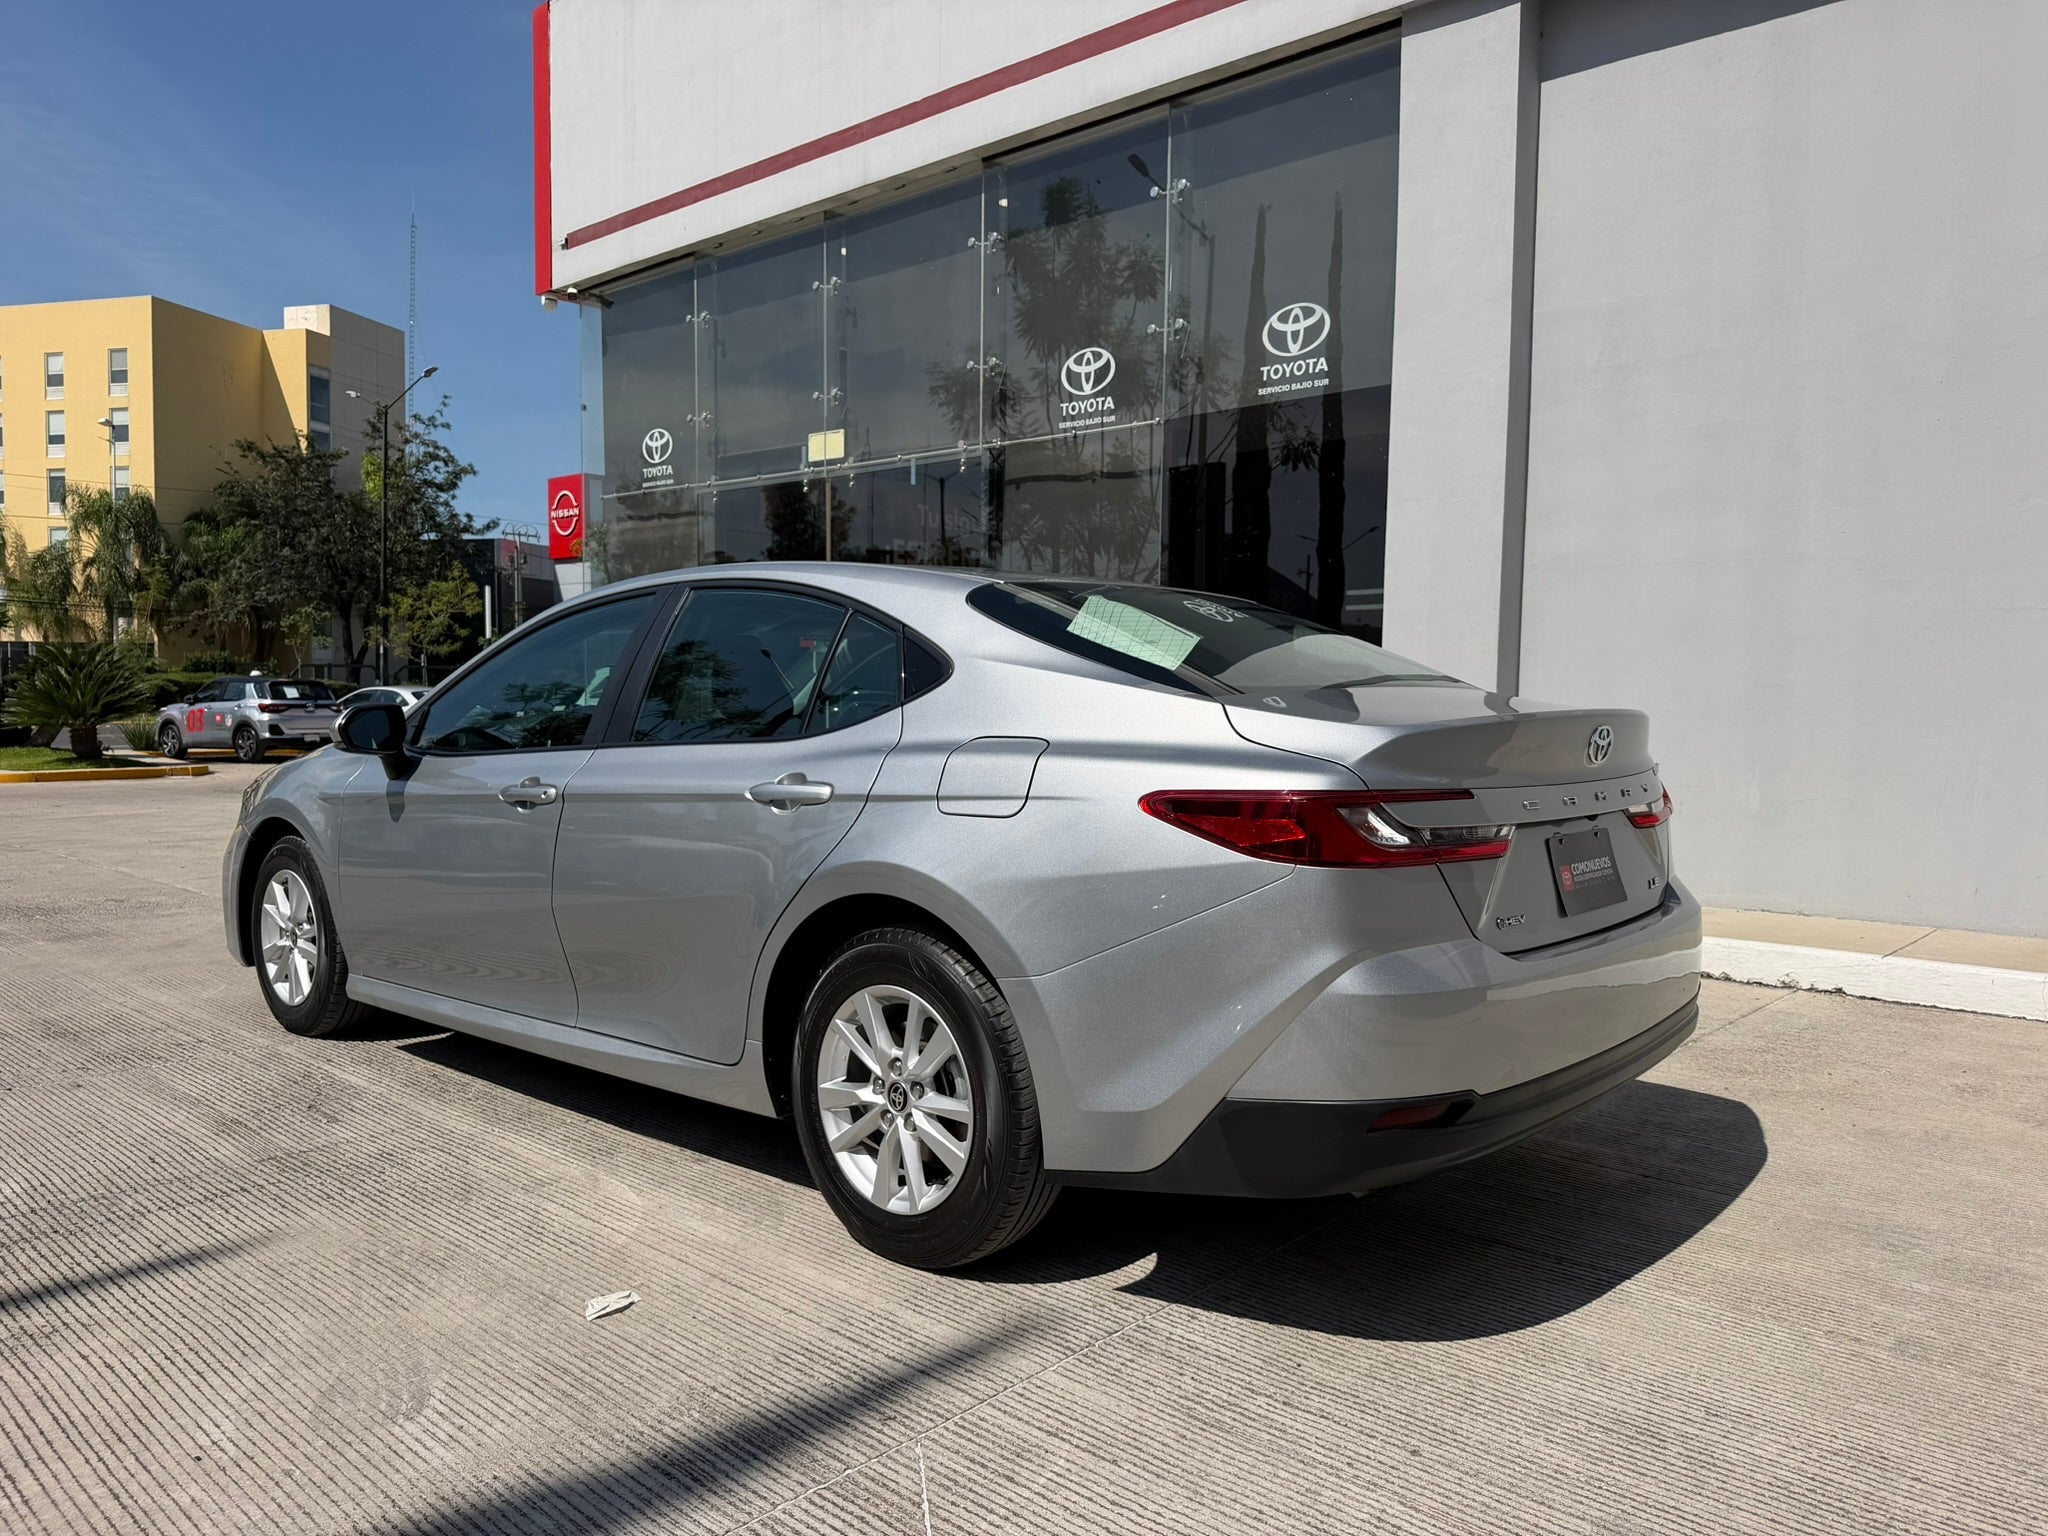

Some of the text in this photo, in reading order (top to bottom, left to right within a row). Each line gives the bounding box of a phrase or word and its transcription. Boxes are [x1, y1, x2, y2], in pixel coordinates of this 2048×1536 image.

[1260, 357, 1329, 381] TOYOTA
[1257, 384, 1290, 396] SERVICIO
[1314, 378, 1330, 387] SUR
[1060, 396, 1115, 416] TOYOTA
[642, 465, 674, 478] TOYOTA
[551, 506, 579, 519] NISSAN
[187, 708, 205, 733] 03
[1522, 783, 1649, 810] CAMRY
[1571, 856, 1612, 875] COMONUEVOS
[1649, 877, 1660, 889] LE
